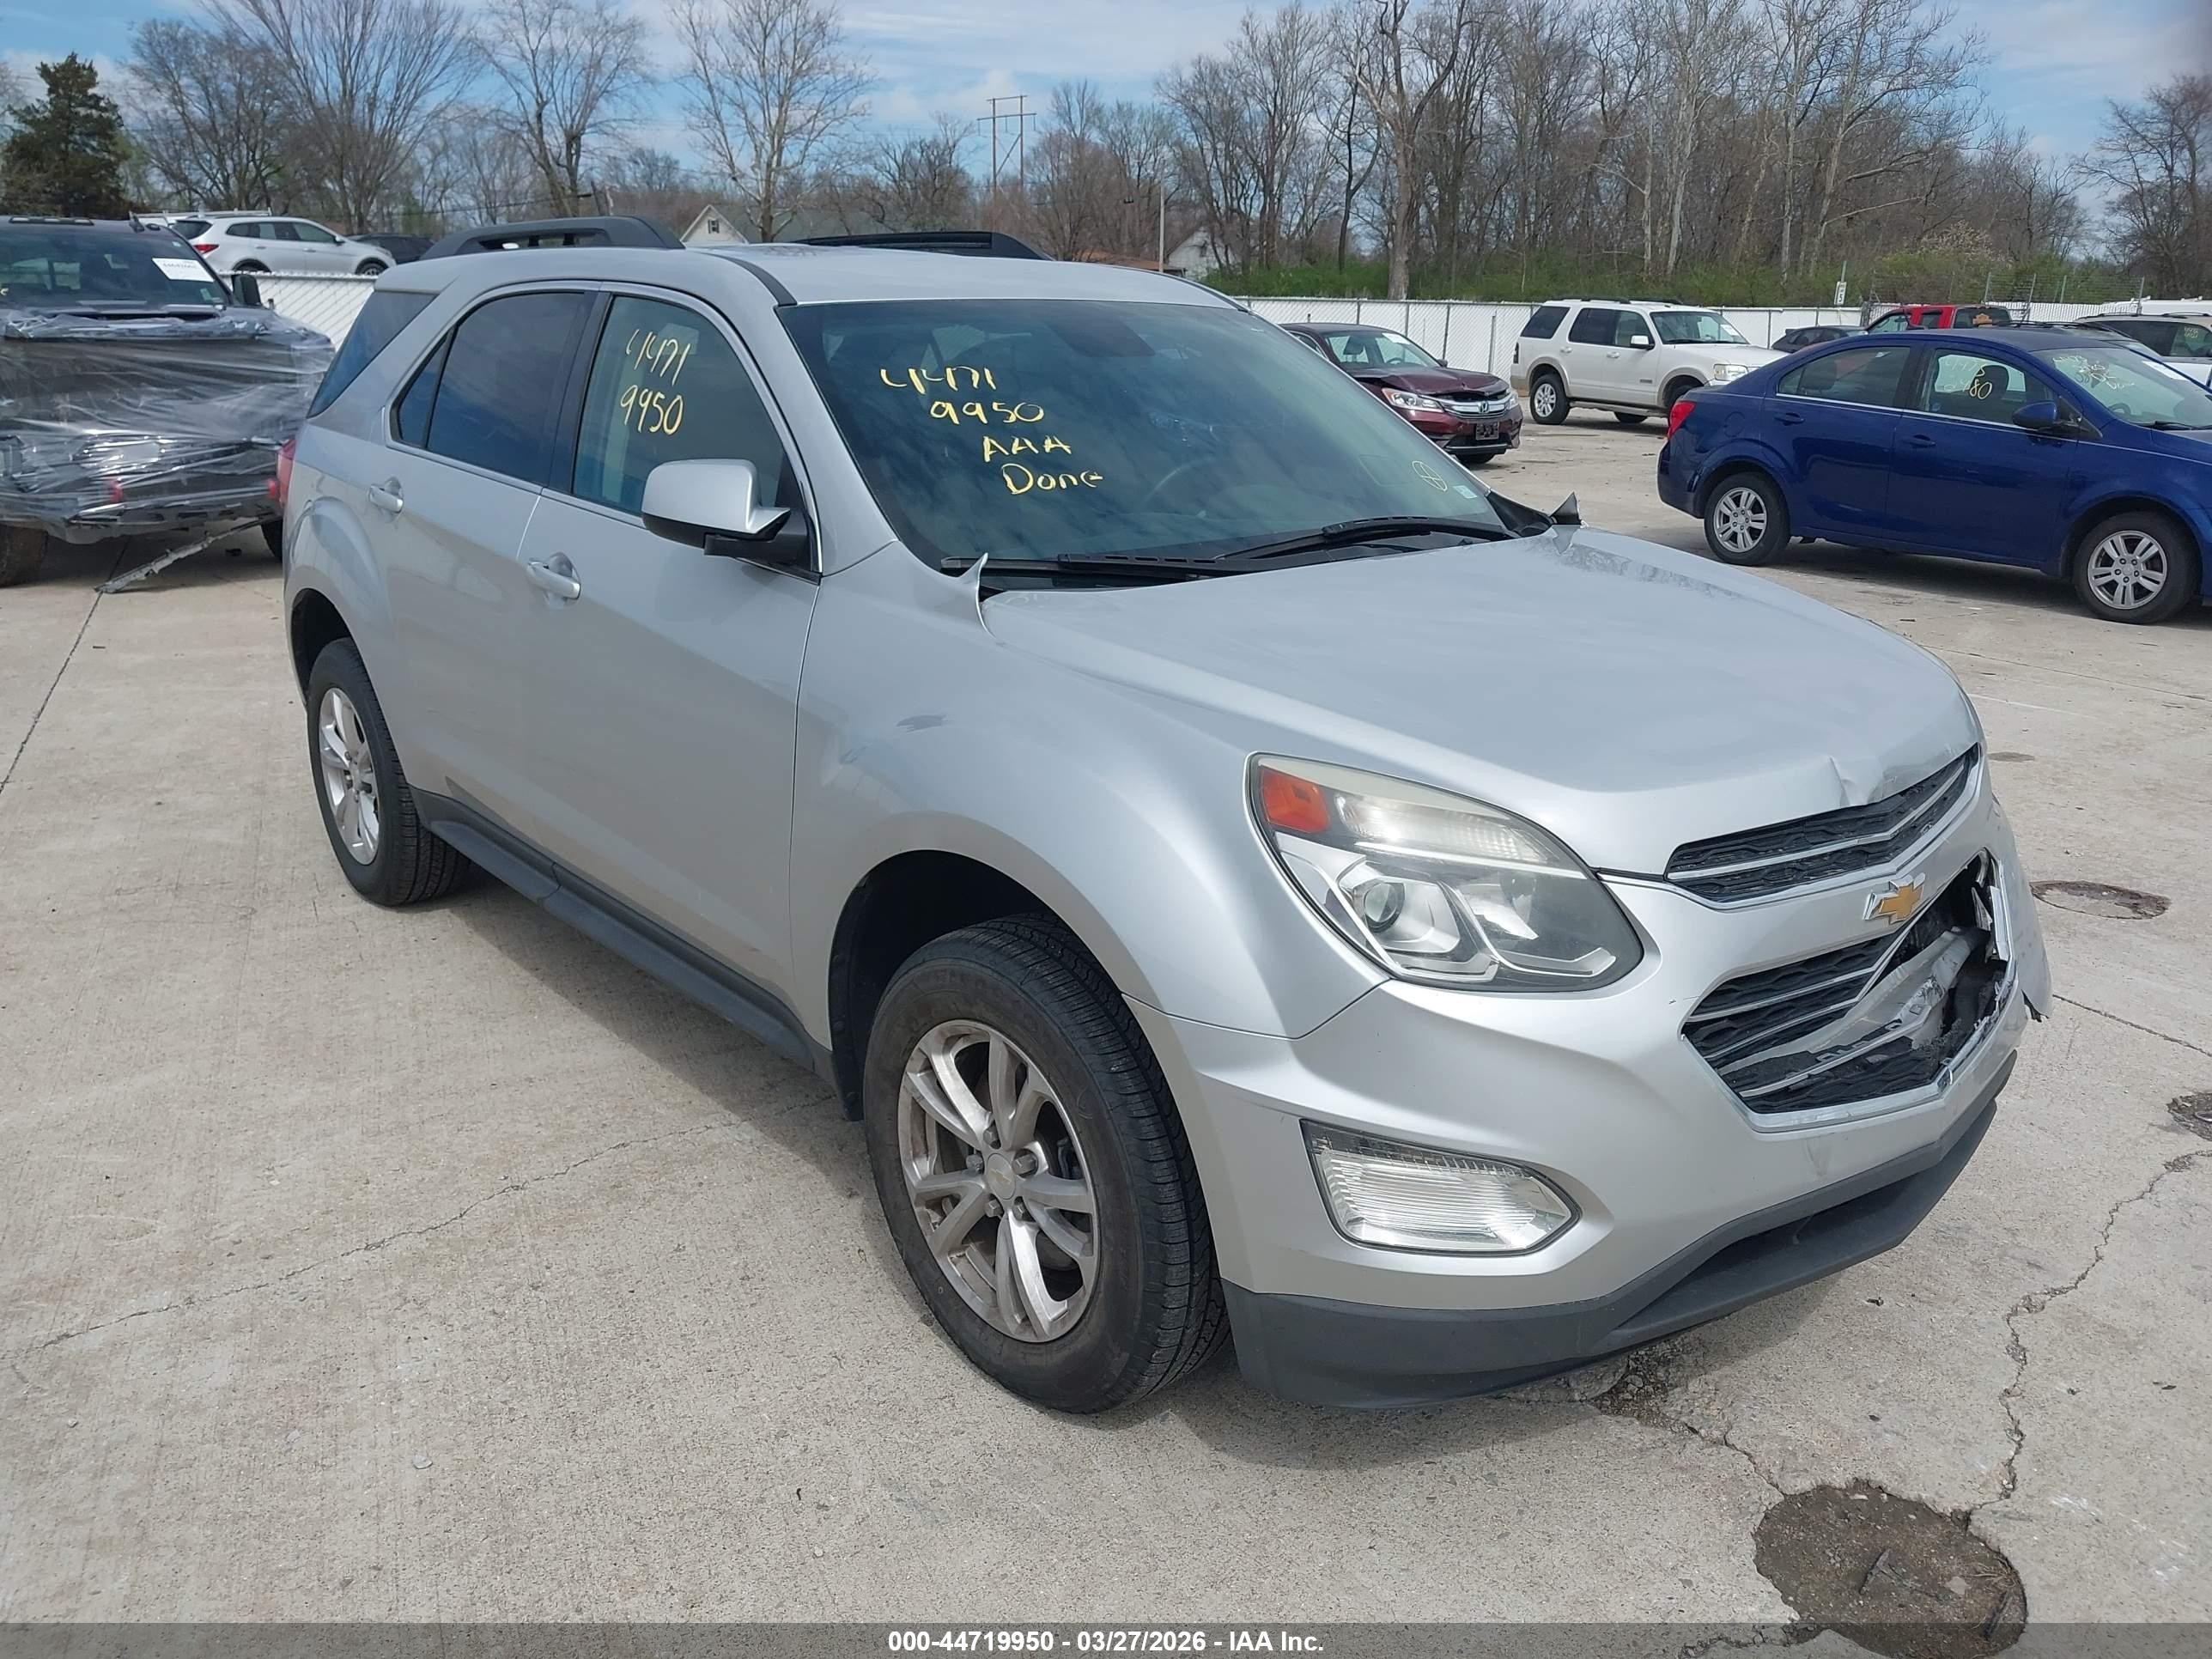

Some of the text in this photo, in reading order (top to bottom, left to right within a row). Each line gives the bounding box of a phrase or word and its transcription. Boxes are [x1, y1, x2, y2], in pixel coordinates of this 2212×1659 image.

[626, 329, 690, 386] 4471
[880, 366, 996, 395] 4471
[620, 384, 684, 435] 9950
[930, 401, 1044, 424] 9950
[1001, 463, 1103, 495] Done
